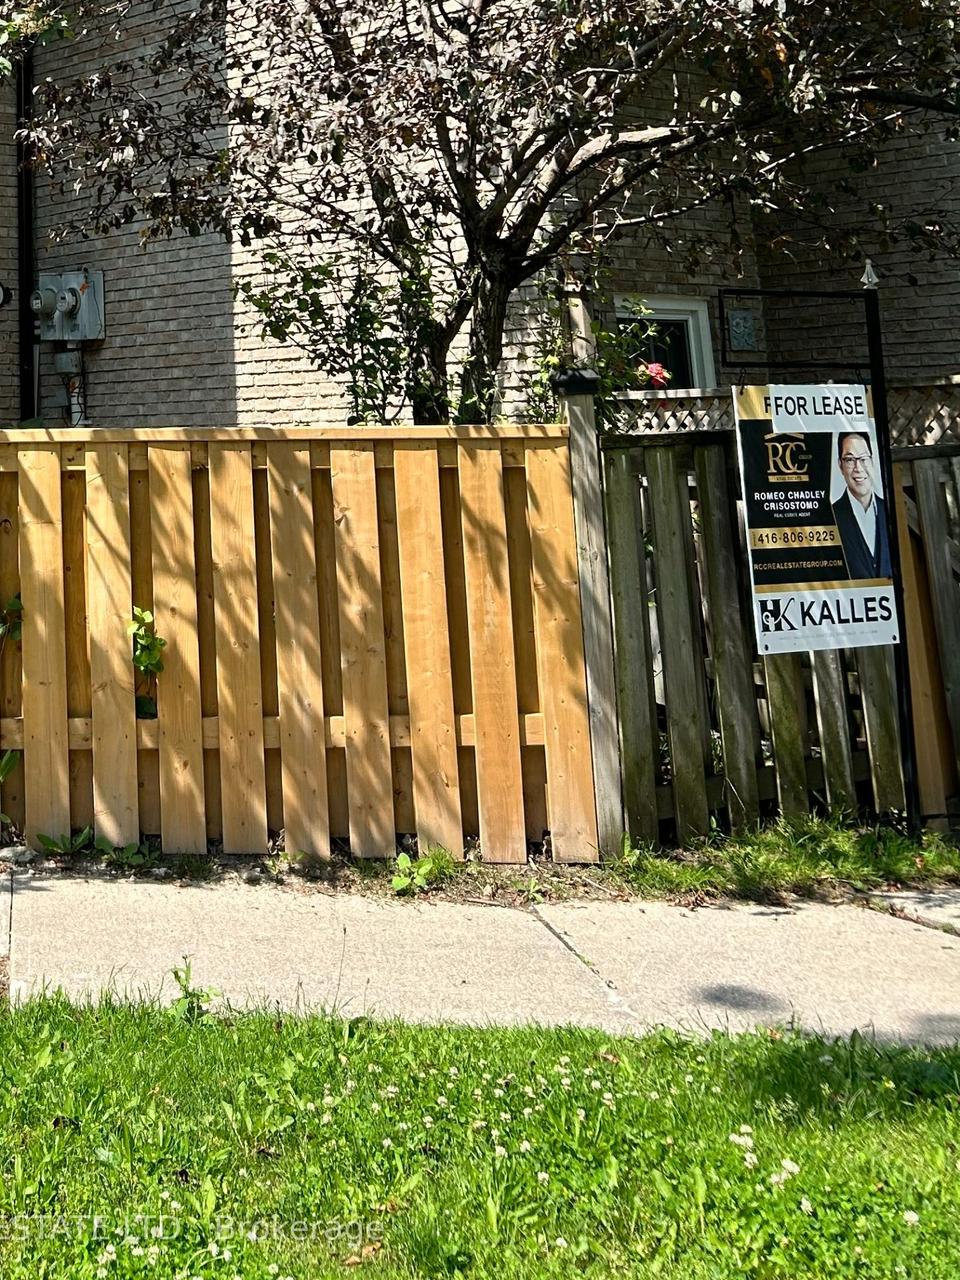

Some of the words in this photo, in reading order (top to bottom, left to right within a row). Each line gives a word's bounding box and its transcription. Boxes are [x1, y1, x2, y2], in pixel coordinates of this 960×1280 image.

[774, 396, 809, 416] FOR
[812, 396, 865, 416] LEASE
[754, 491, 785, 500] ROMEO
[787, 490, 825, 499] CHADLEY
[763, 501, 819, 511] CRISOSTOMO
[753, 560, 843, 570] RCCREALESTATEGROUP.COM
[800, 595, 892, 627] KALLES
